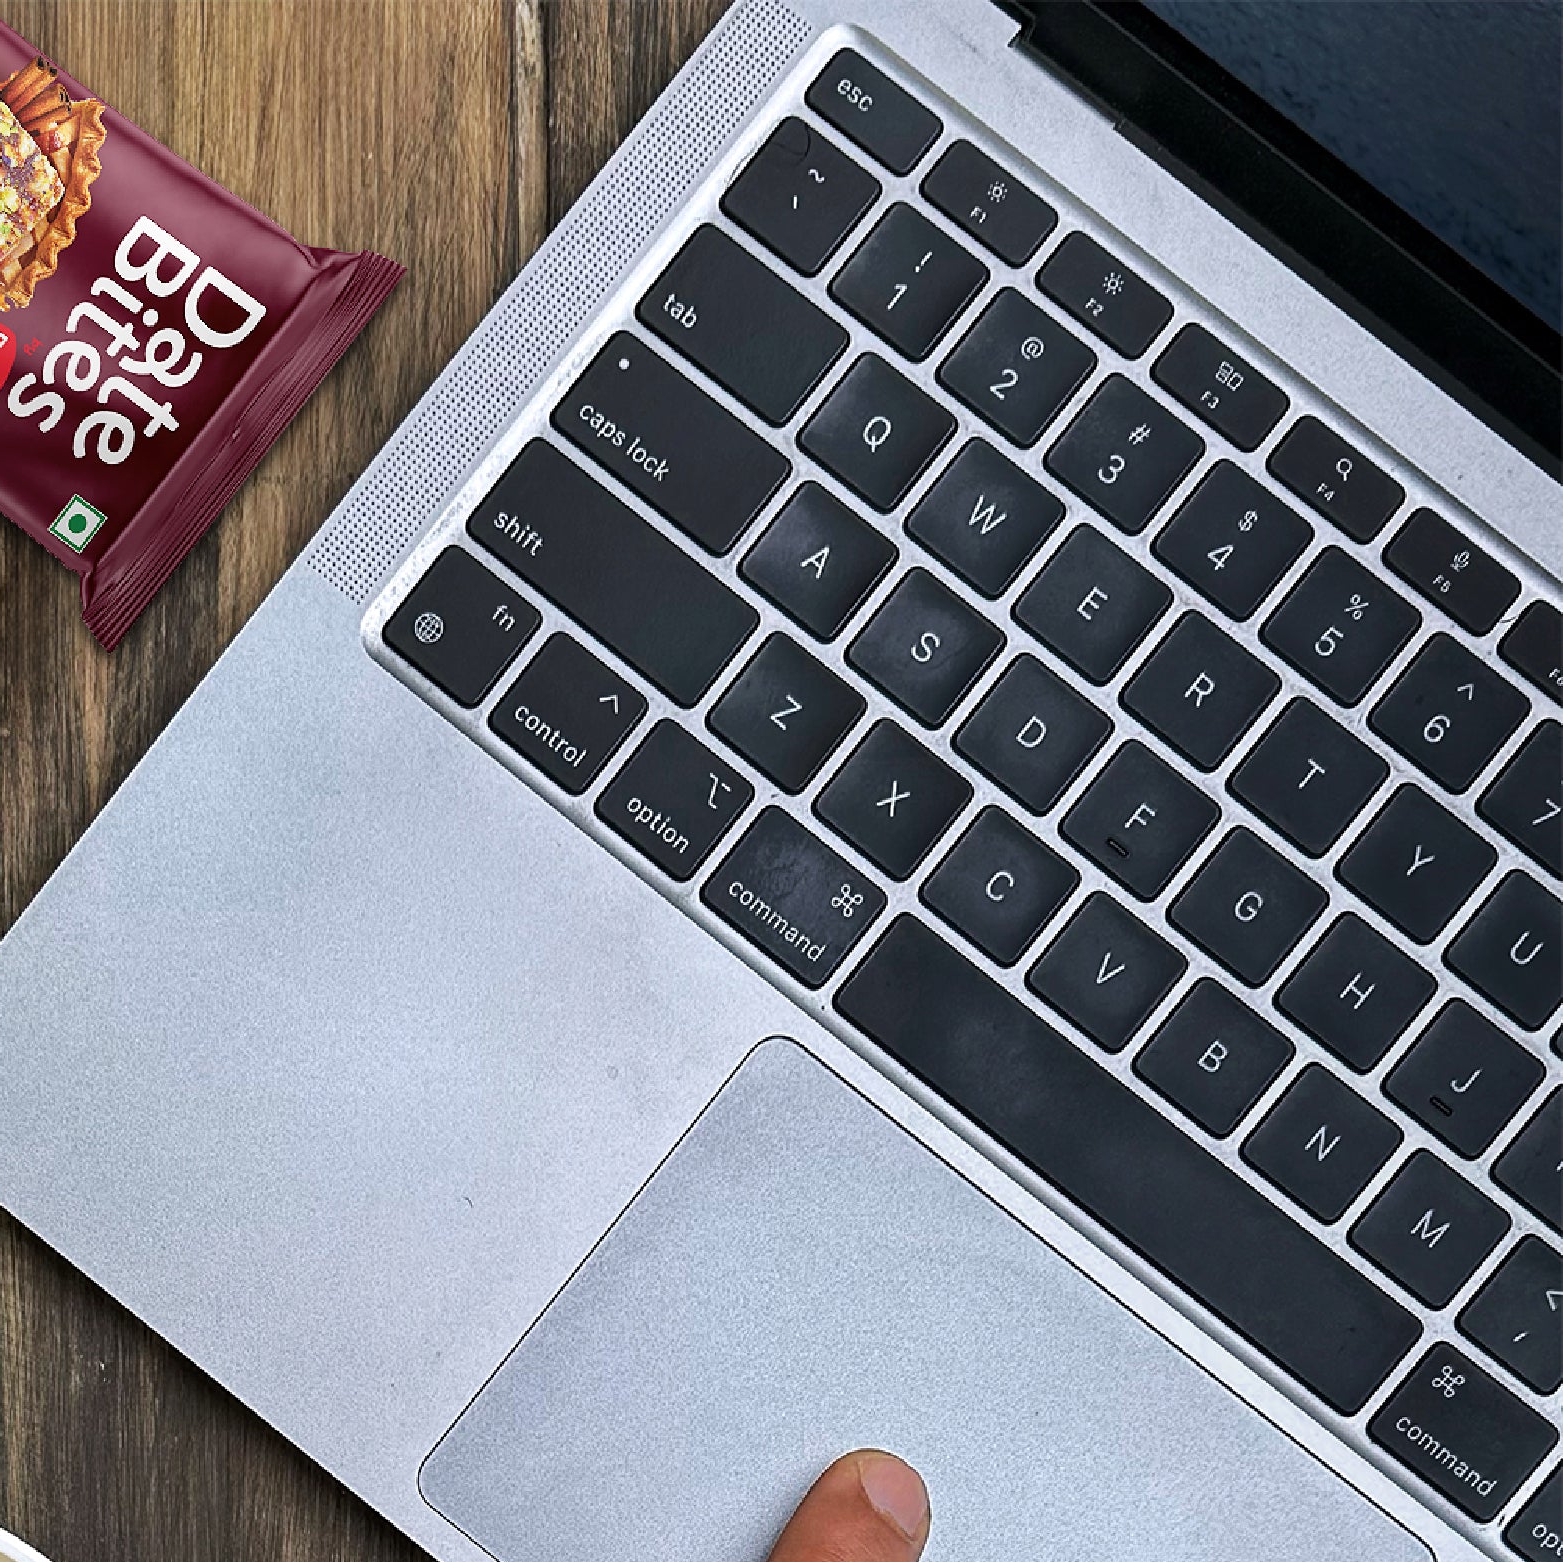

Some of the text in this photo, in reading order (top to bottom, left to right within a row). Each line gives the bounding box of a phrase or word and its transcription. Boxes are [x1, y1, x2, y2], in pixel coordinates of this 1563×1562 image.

[837, 79, 873, 112] esc
[970, 206, 987, 224] F1
[664, 293, 697, 329] tab
[887, 283, 908, 310] 1
[6, 215, 202, 434] Bites
[73, 266, 267, 466] Date
[989, 368, 1019, 401] 2
[578, 403, 670, 482] caps lock
[862, 416, 893, 453] Q
[1098, 454, 1126, 485] 3
[968, 494, 1008, 535] W
[493, 511, 544, 557] shift
[799, 546, 830, 580] A
[1207, 544, 1234, 571] 4
[492, 604, 516, 632] fn
[1076, 586, 1109, 621] E
[910, 632, 941, 663] S
[1314, 626, 1344, 657] 5
[1184, 672, 1216, 708] R
[770, 694, 804, 732] Z
[1423, 715, 1451, 743] 6
[514, 703, 587, 770] control
[1015, 715, 1047, 748] D
[1298, 758, 1326, 789] T
[876, 780, 911, 818] X
[1124, 802, 1157, 829] F
[626, 795, 689, 855] option
[1404, 845, 1435, 877] Y
[985, 870, 1014, 901] C
[728, 881, 825, 964] command
[1232, 891, 1264, 923] G
[1510, 931, 1544, 965] U
[1096, 951, 1126, 986] V
[1339, 972, 1376, 1011] H
[1198, 1040, 1228, 1073] B
[1451, 1068, 1482, 1093] J
[1303, 1125, 1341, 1163] N
[1410, 1207, 1451, 1249] M
[1395, 1416, 1498, 1498] command
